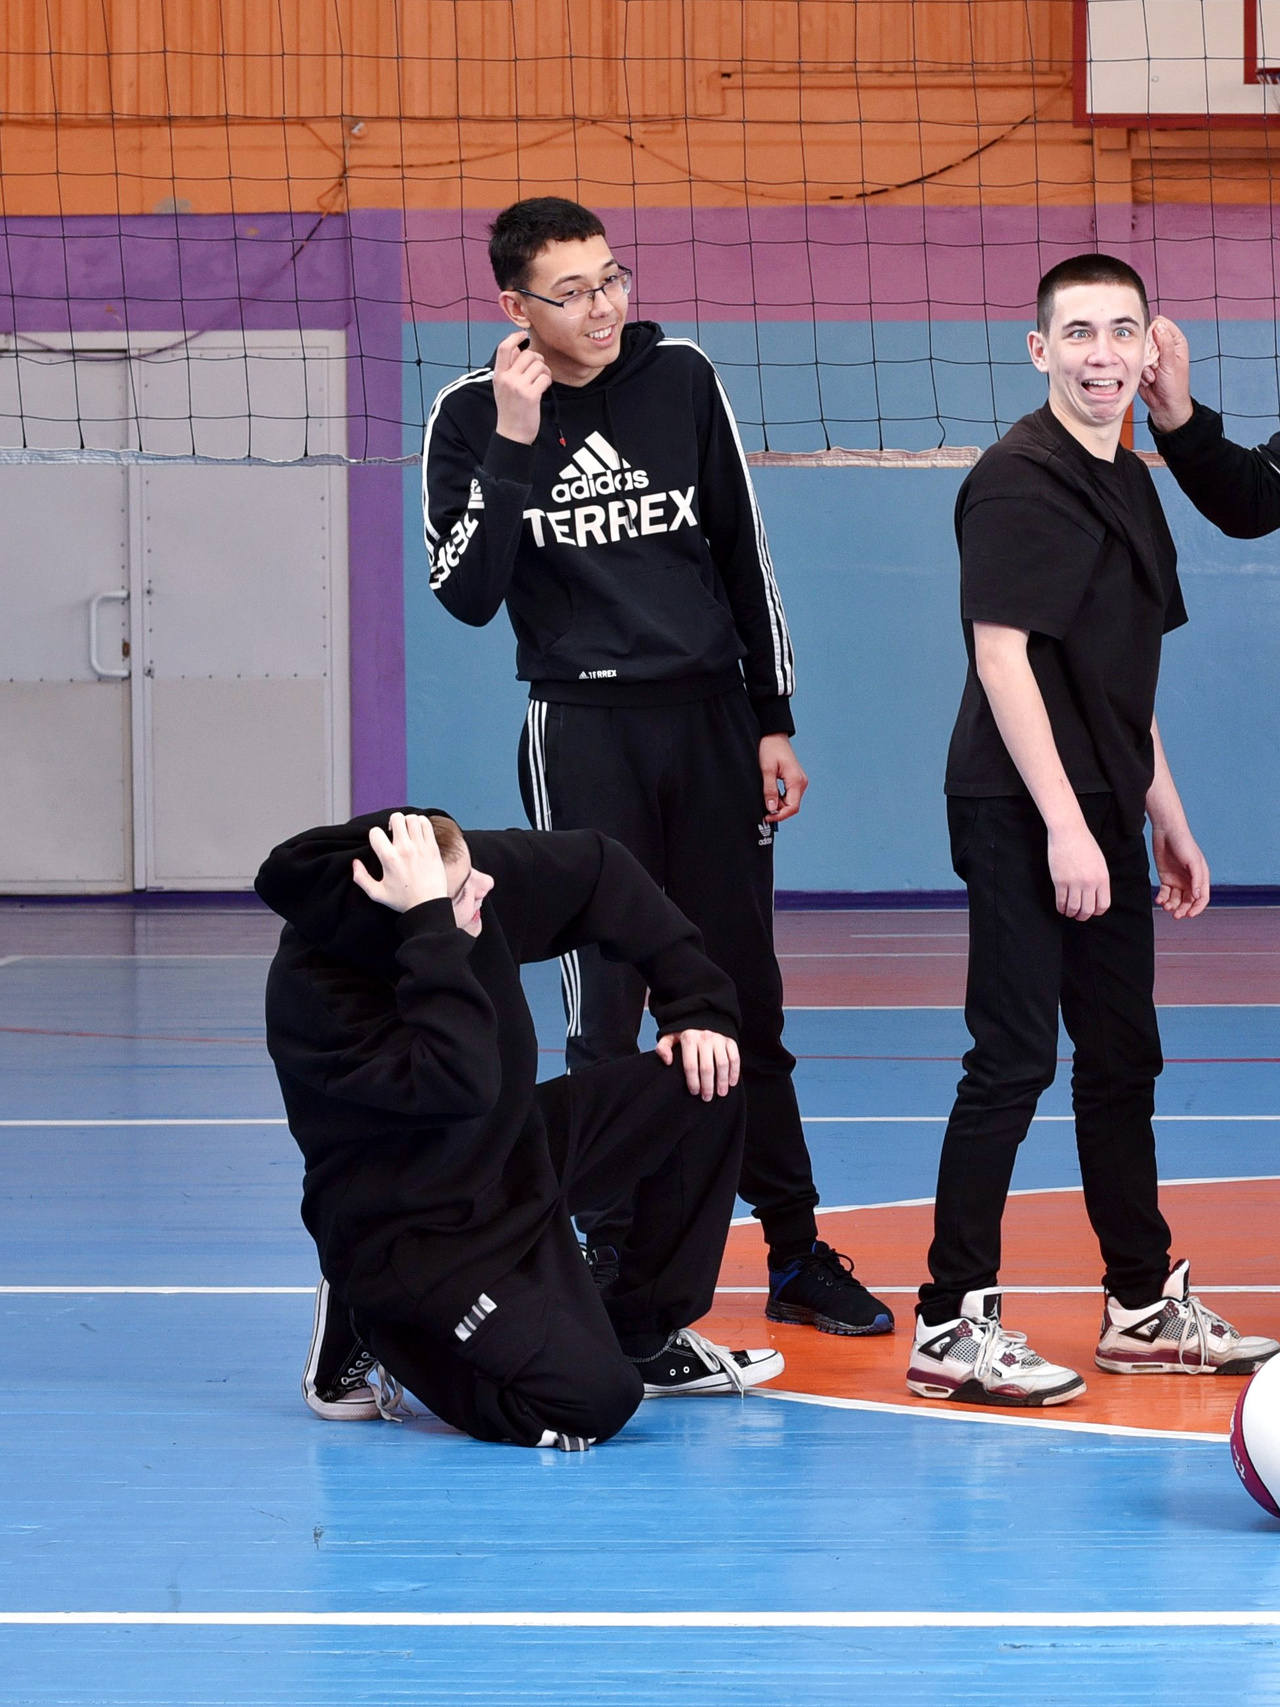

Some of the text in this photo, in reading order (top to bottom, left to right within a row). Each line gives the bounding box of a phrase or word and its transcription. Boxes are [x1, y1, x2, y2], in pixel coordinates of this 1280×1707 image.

[552, 469, 649, 503] adidas
[523, 486, 697, 547] TERREX
[588, 669, 617, 680] TERREX
